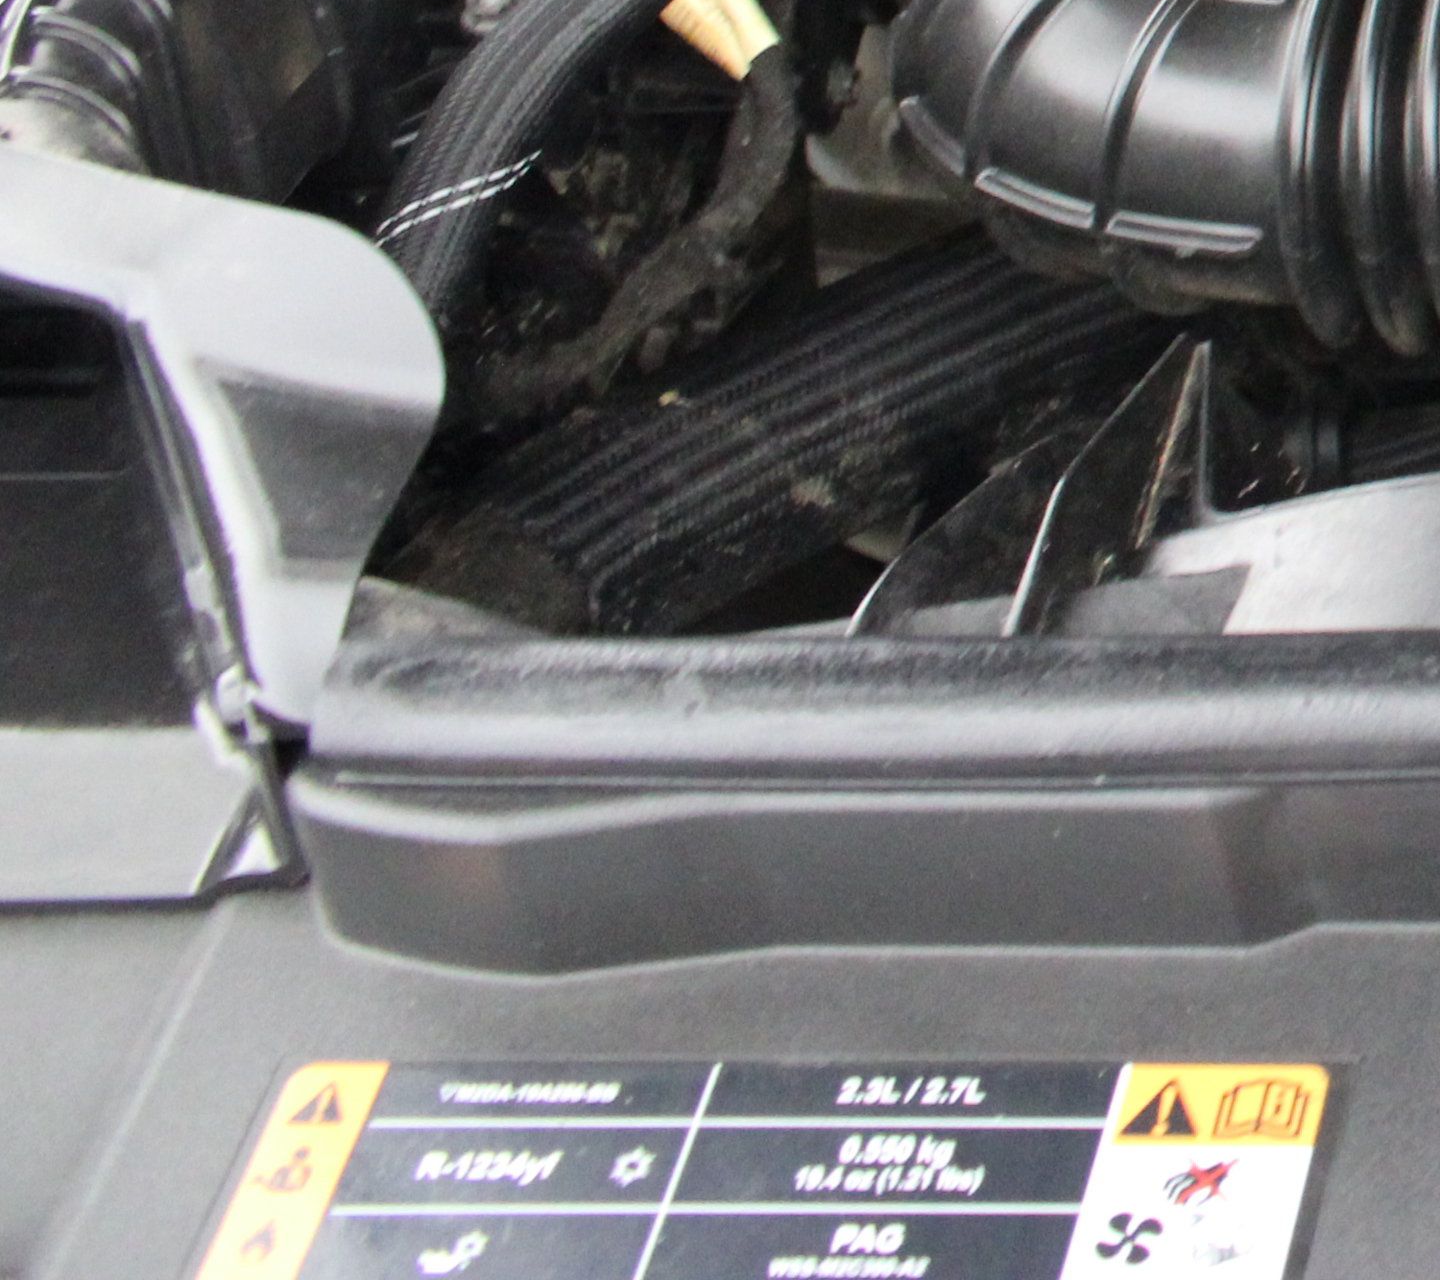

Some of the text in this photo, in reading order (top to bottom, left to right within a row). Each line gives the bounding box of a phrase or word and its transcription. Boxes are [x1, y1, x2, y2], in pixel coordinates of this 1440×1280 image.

[836, 1075, 987, 1105] 2.3L / 2.7L
[415, 1150, 564, 1186] R-1234yf
[915, 1133, 957, 1170] kg
[830, 1222, 907, 1254] PAG
